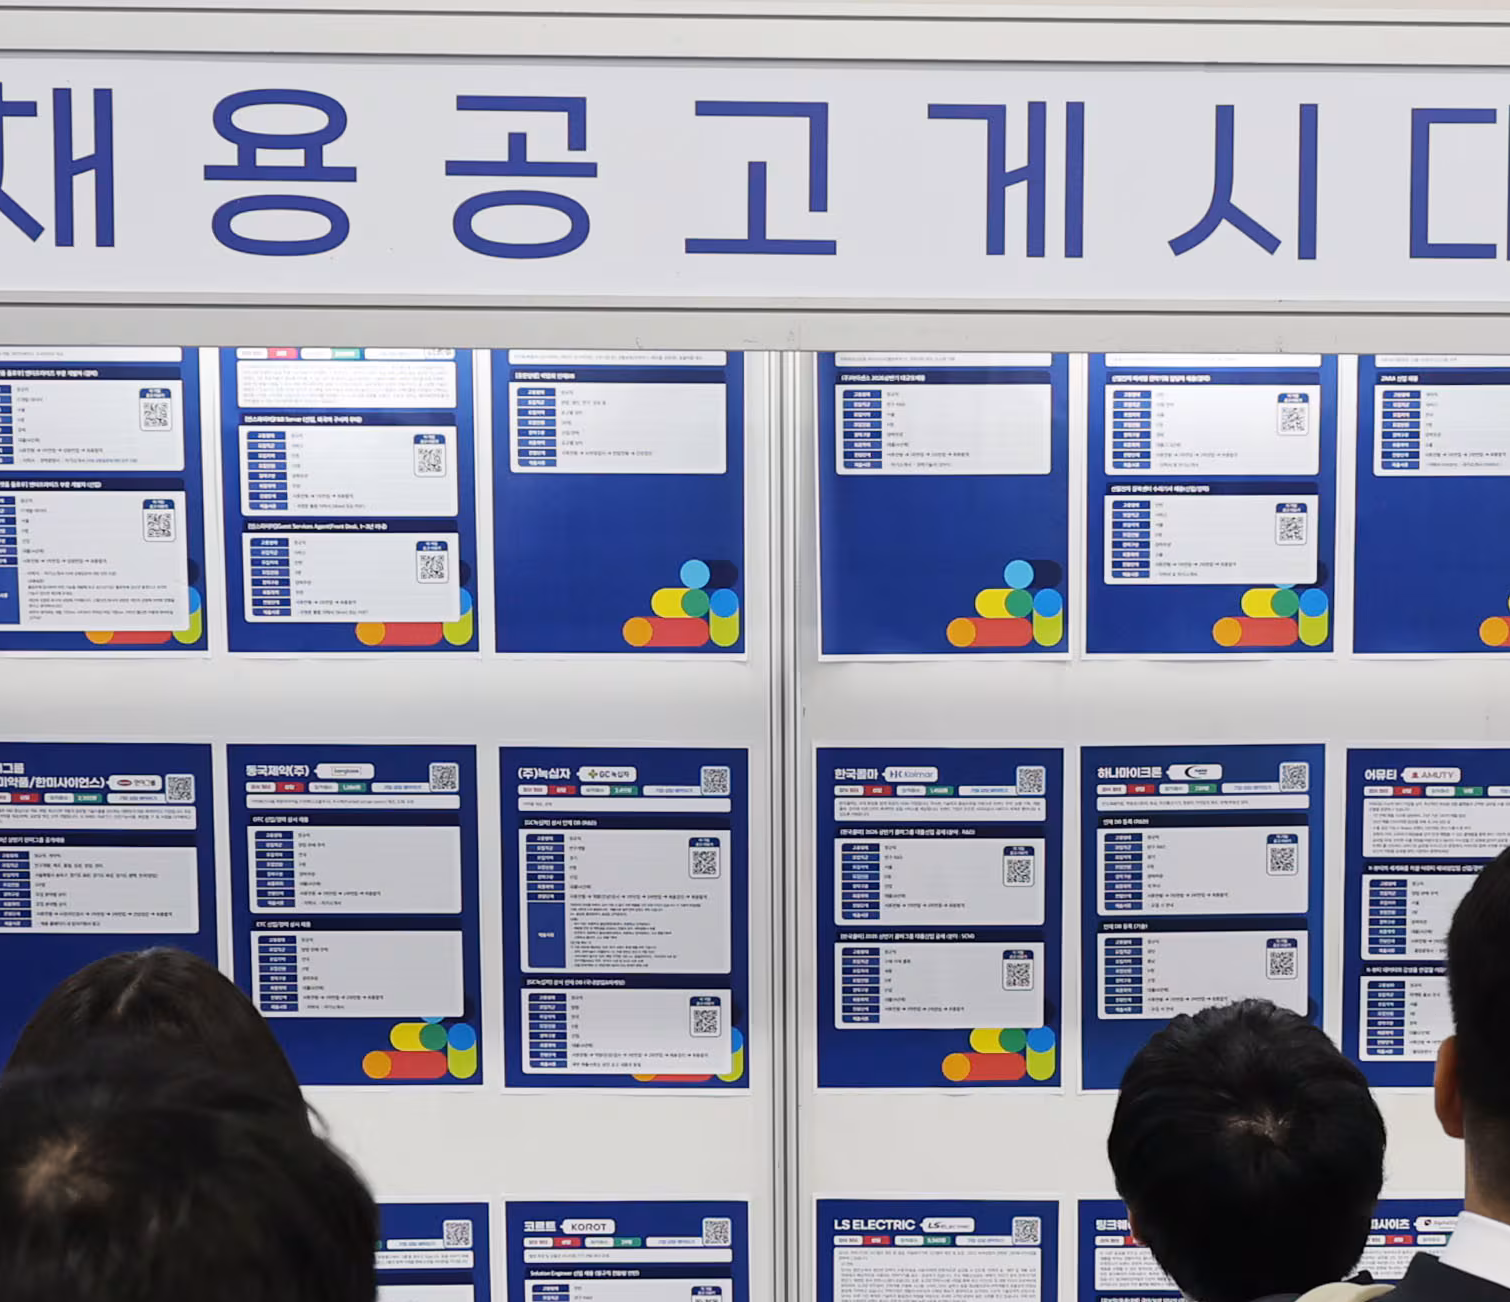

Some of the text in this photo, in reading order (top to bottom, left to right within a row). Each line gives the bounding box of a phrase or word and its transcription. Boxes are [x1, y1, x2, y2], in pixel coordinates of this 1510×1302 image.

[246, 765, 309, 777] 동국제약(주)
[518, 768, 570, 779] (주)녹십자
[834, 768, 878, 779] 한국콜마
[1097, 767, 1162, 778] 하나마이크론
[1364, 769, 1397, 780] 어뮤티
[571, 1223, 607, 1231] KOROT
[834, 1219, 916, 1230] LS ELECTRIC
